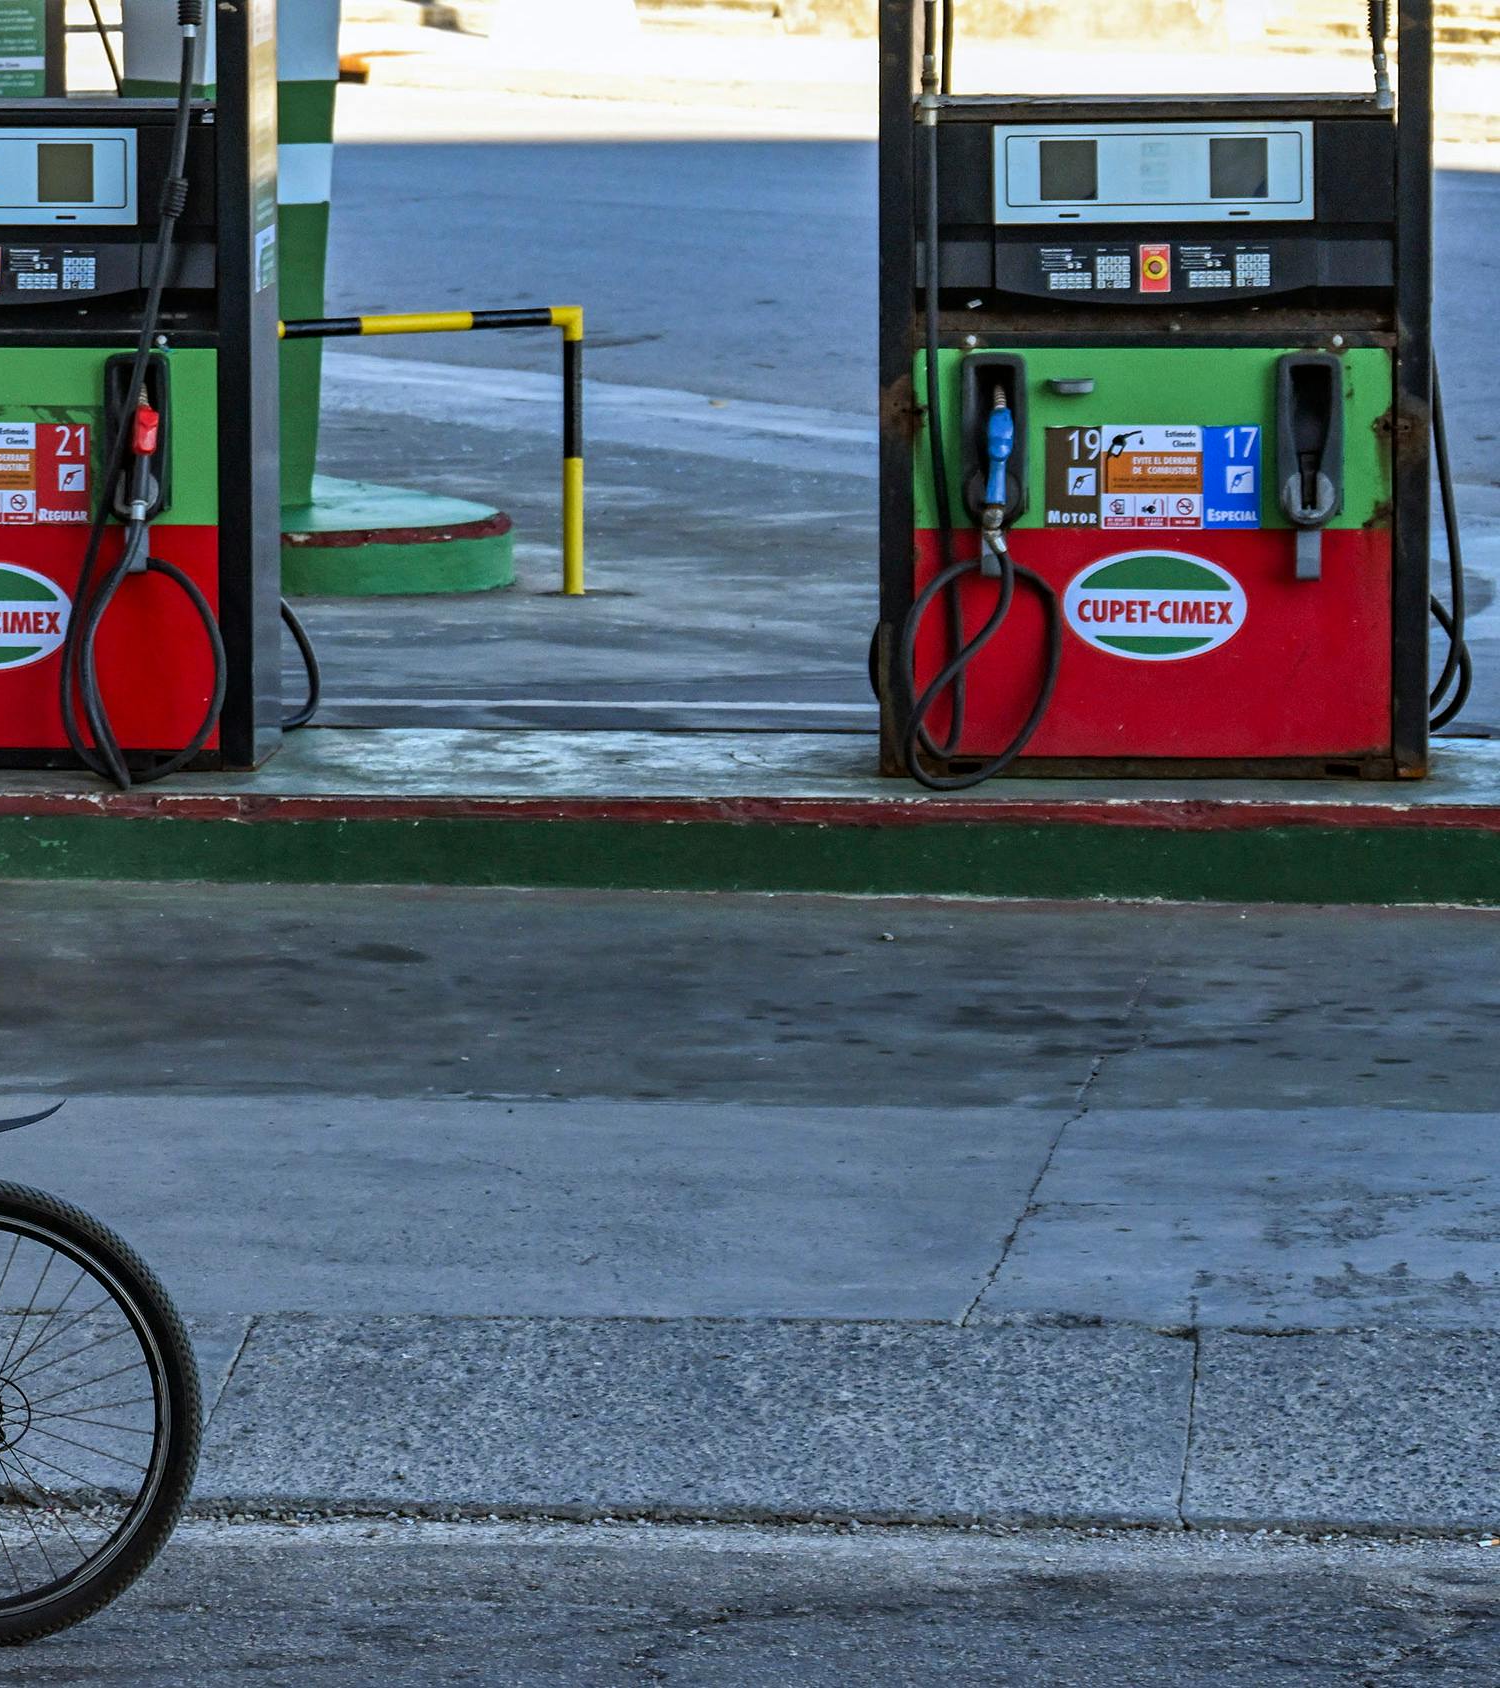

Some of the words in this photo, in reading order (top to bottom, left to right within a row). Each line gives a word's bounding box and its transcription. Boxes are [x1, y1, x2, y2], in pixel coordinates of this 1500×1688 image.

[55, 425, 86, 456] 21
[1068, 429, 1101, 461] 19
[1224, 427, 1258, 458] 17
[38, 508, 88, 521] REGULAR
[1048, 510, 1098, 524] MOTOR
[1207, 508, 1258, 521] ESPECIAL
[1077, 599, 1234, 625] CUPET-CIMEX
